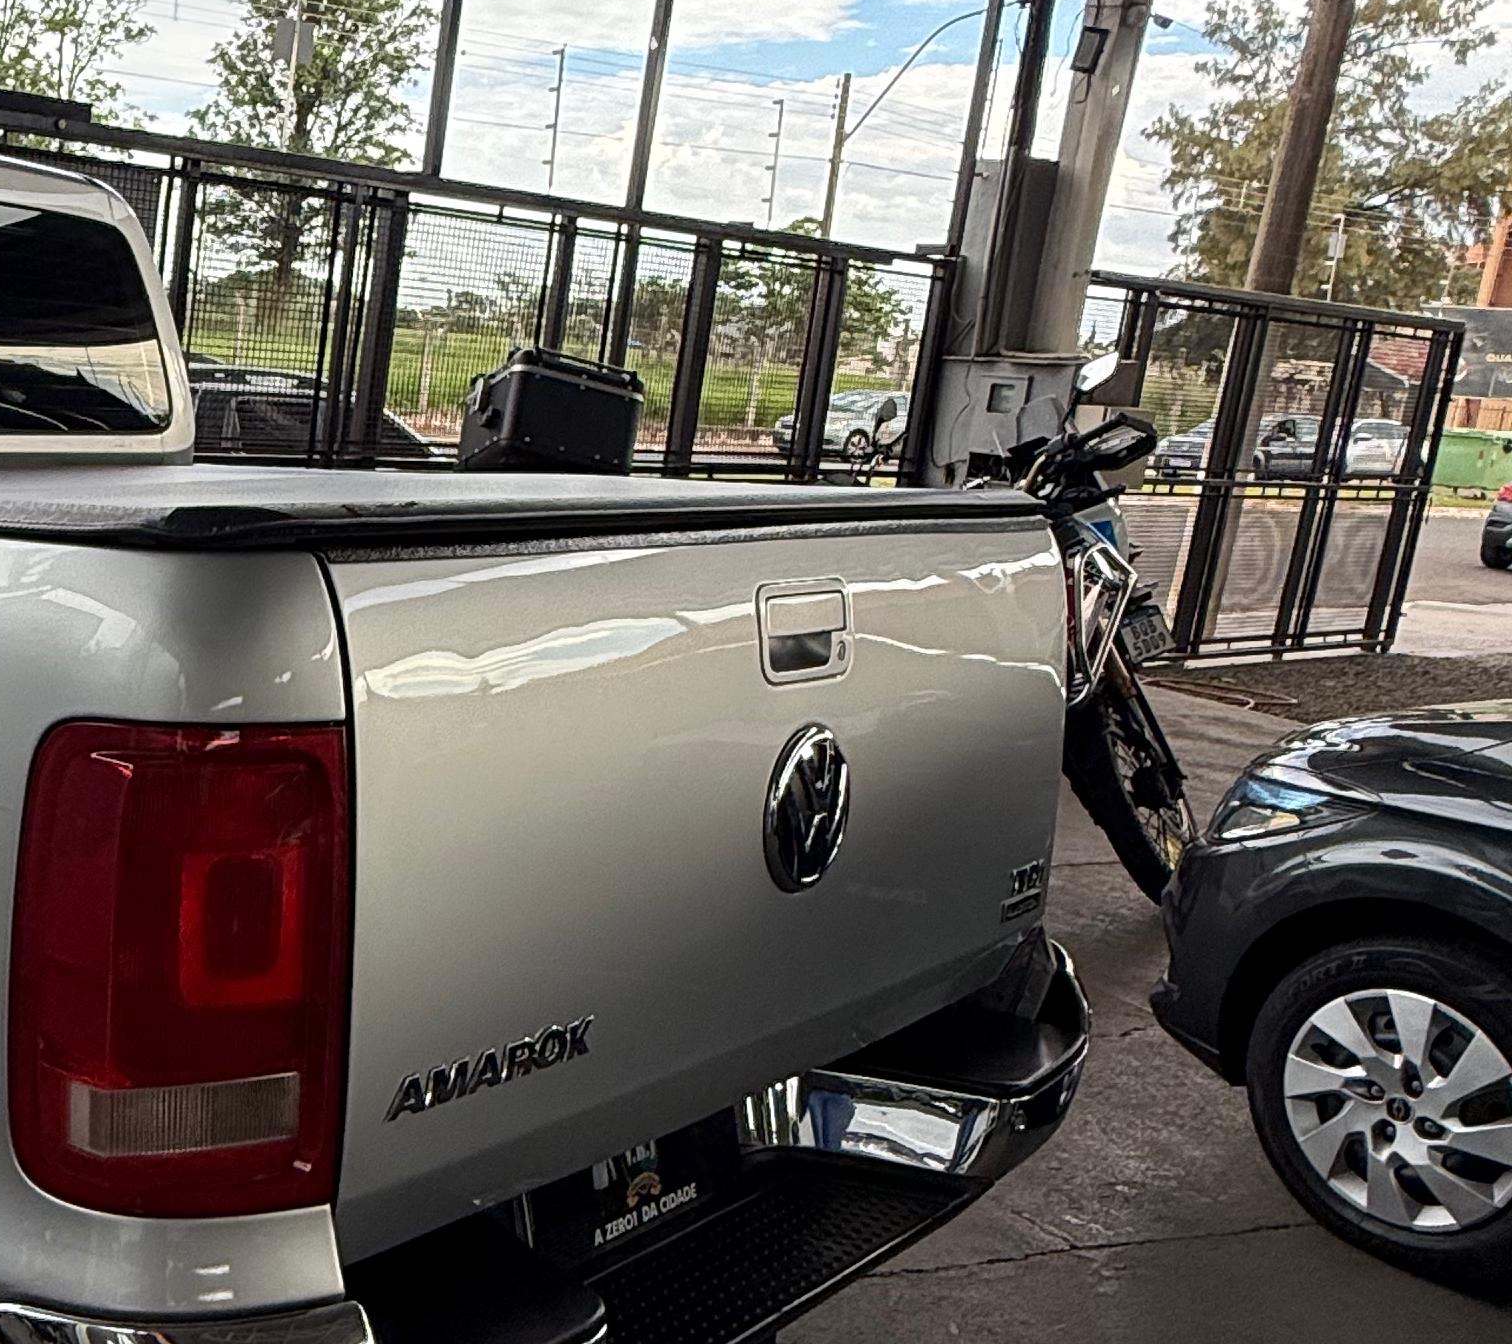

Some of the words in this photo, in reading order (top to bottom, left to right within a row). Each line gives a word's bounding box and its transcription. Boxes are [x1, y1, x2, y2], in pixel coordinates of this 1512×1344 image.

[384, 1014, 595, 1122] AMAROK
[593, 1228, 604, 1247] A
[604, 1212, 639, 1241] ZERO1
[641, 1201, 659, 1222] DA
[659, 1182, 698, 1213] CIDADE
